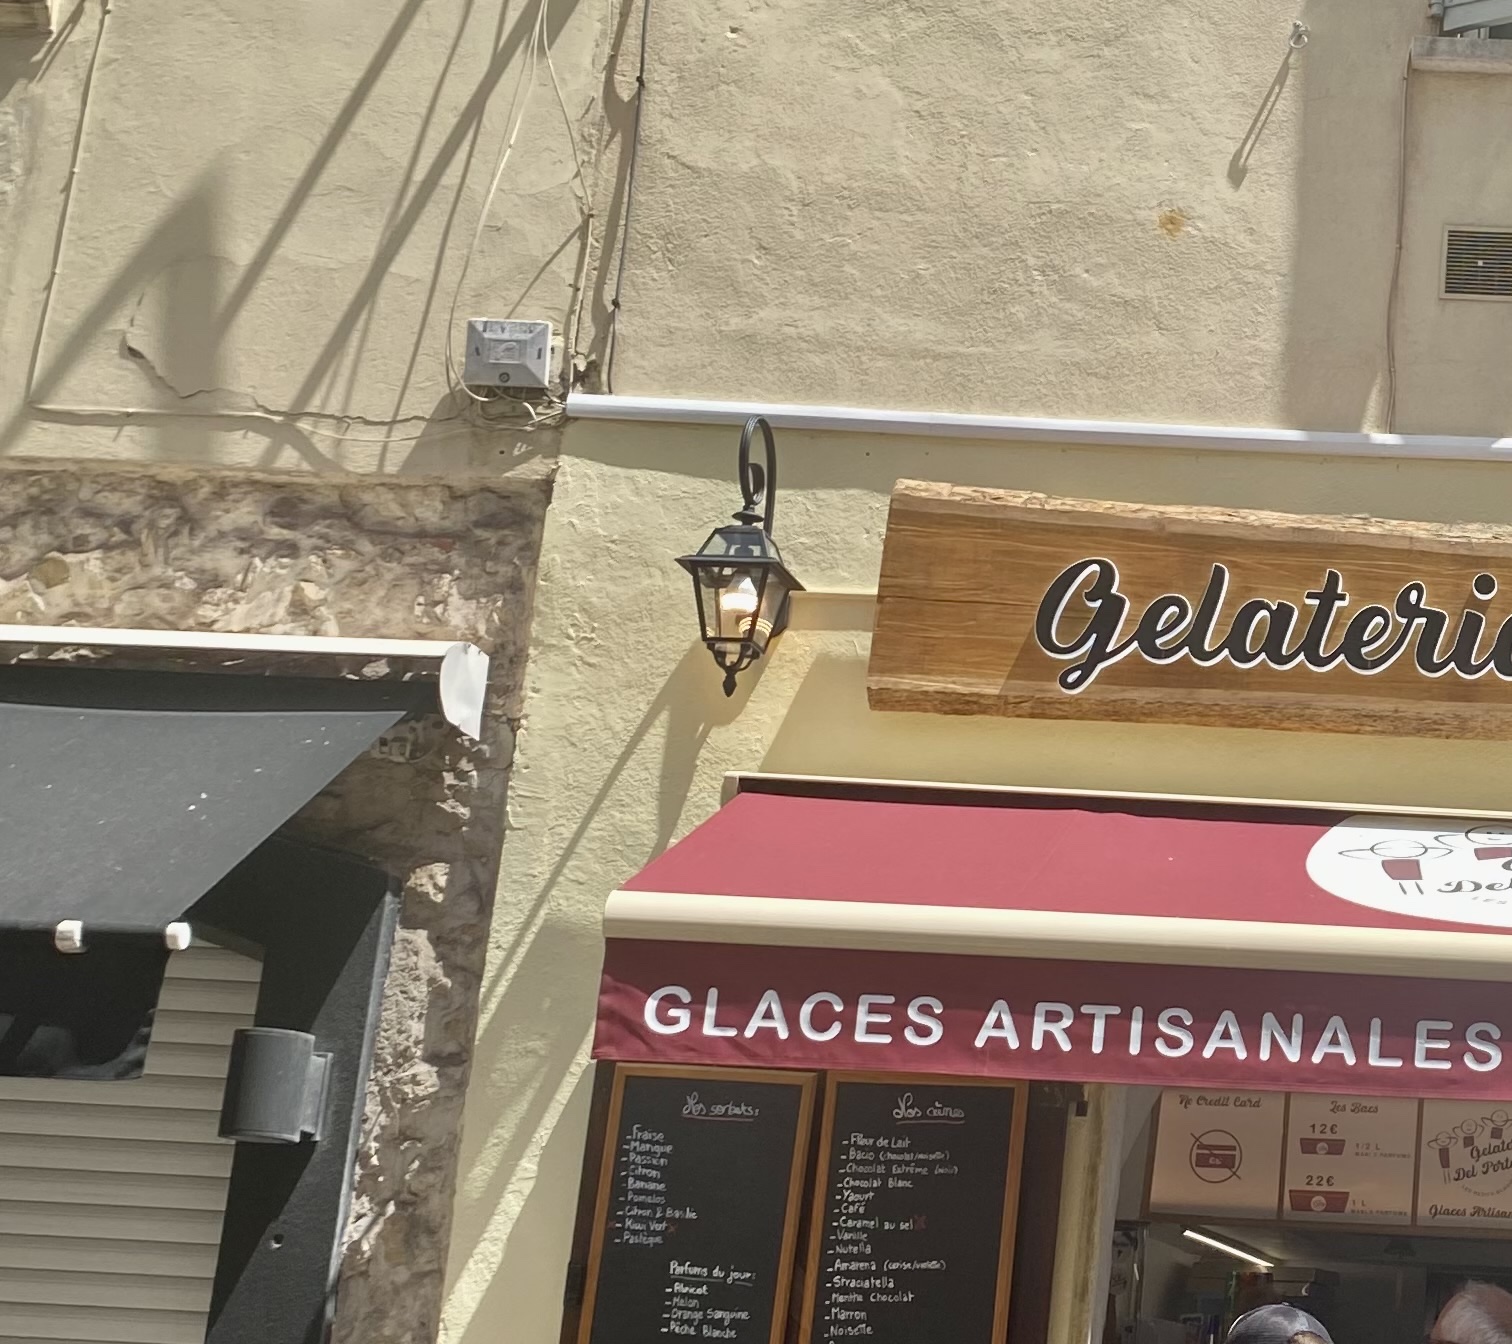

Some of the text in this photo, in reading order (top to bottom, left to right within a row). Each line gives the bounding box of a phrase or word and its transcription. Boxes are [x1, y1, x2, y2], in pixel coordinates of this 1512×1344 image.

[642, 984, 944, 1047] GLACES
[974, 998, 1502, 1075] ARTISANALES
[1233, 1097, 1262, 1108] Card
[1309, 1123, 1338, 1135] 12€
[876, 1136, 889, 1147] de
[891, 1136, 911, 1148] Lait
[630, 1141, 673, 1157] Mangue
[629, 1153, 668, 1166] Passion
[846, 1163, 886, 1174] Chocolat
[1453, 1164, 1478, 1181] Del
[627, 1177, 667, 1191] Banane
[843, 1177, 914, 1188] Chocolat Blanc
[1305, 1175, 1335, 1187] 22€
[841, 1202, 866, 1214] Café
[1428, 1204, 1466, 1219] Glaces
[839, 1216, 914, 1230] Caramel au sel
[836, 1243, 872, 1255] Nutella
[669, 1260, 708, 1276] Parfums
[712, 1265, 725, 1278] du
[671, 1309, 703, 1324] Orange
[831, 1308, 867, 1320] Marron
[703, 1325, 737, 1338] Blanche
